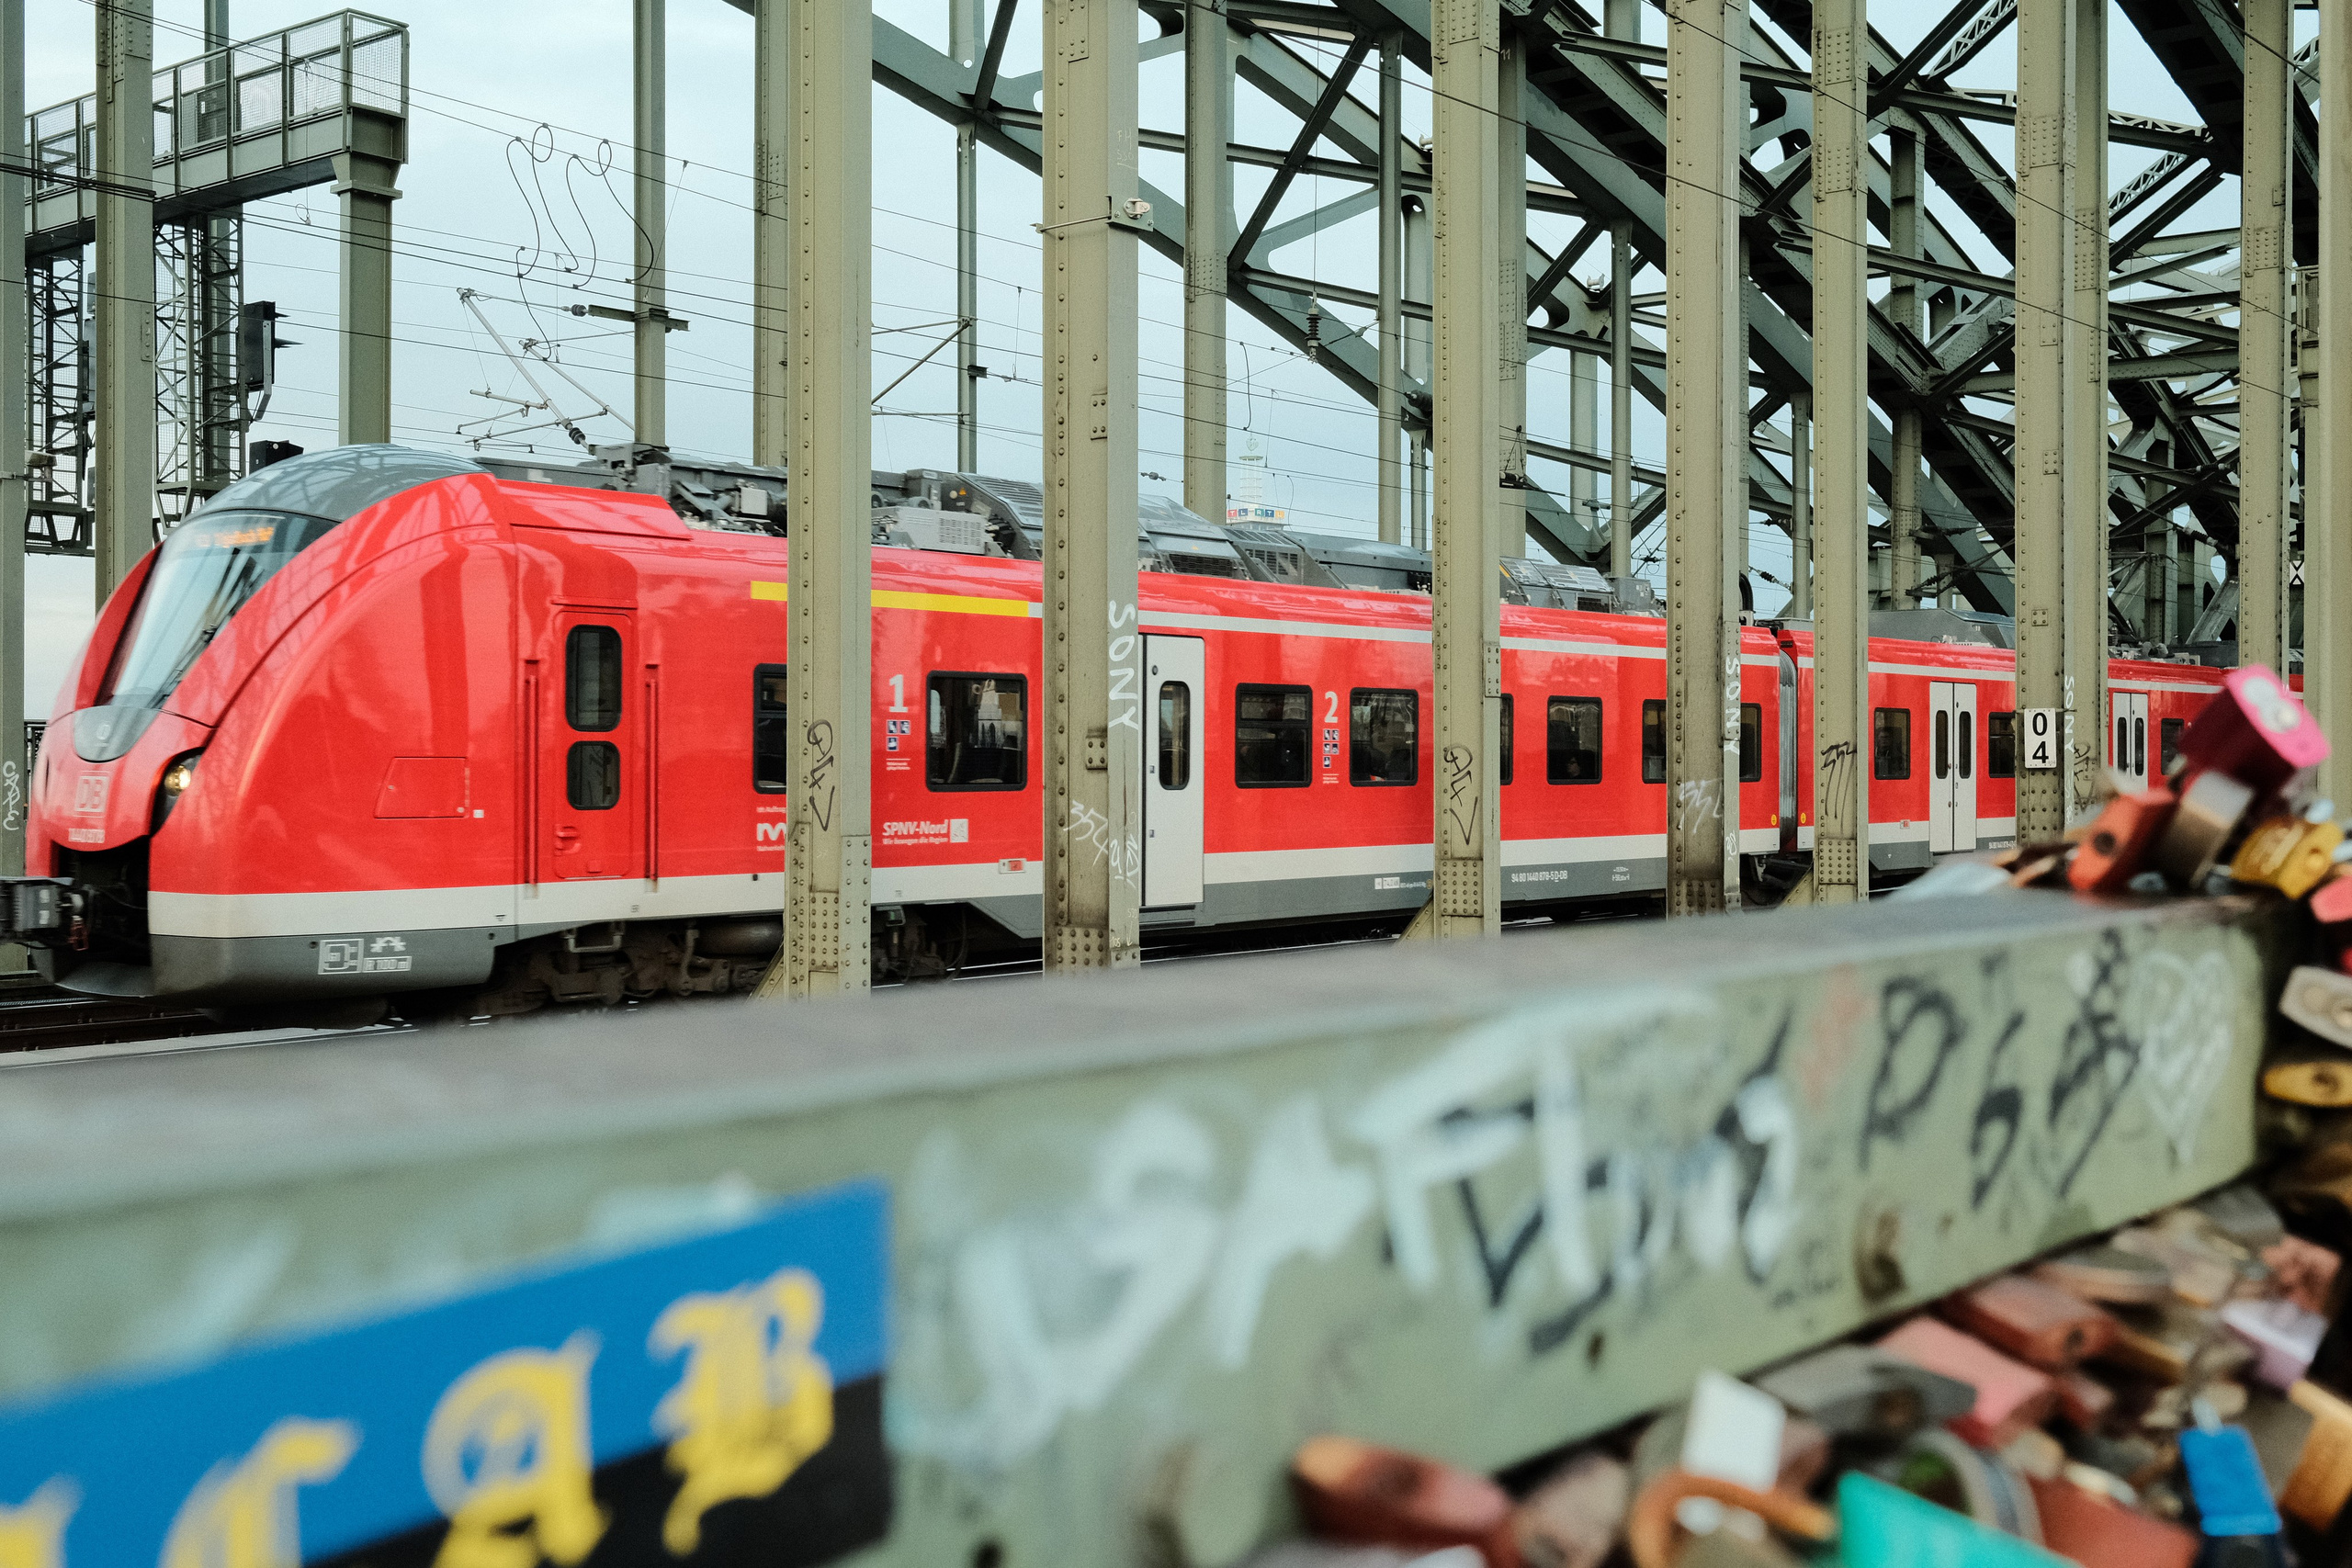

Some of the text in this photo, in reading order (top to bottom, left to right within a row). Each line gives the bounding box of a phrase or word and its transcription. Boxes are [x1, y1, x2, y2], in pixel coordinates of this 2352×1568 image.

[1255, 509, 1284, 519] RTL
[1108, 600, 1138, 729] SONY
[888, 673, 909, 713] 1
[1324, 691, 1339, 723] 2
[1724, 656, 1741, 756] SONY
[2032, 713, 2048, 736] 0
[2064, 675, 2075, 754] SONY
[2032, 740, 2049, 763] 4
[75, 775, 110, 812] DB
[882, 818, 949, 836] SPNV-Nord
[1519, 872, 1526, 882] 80
